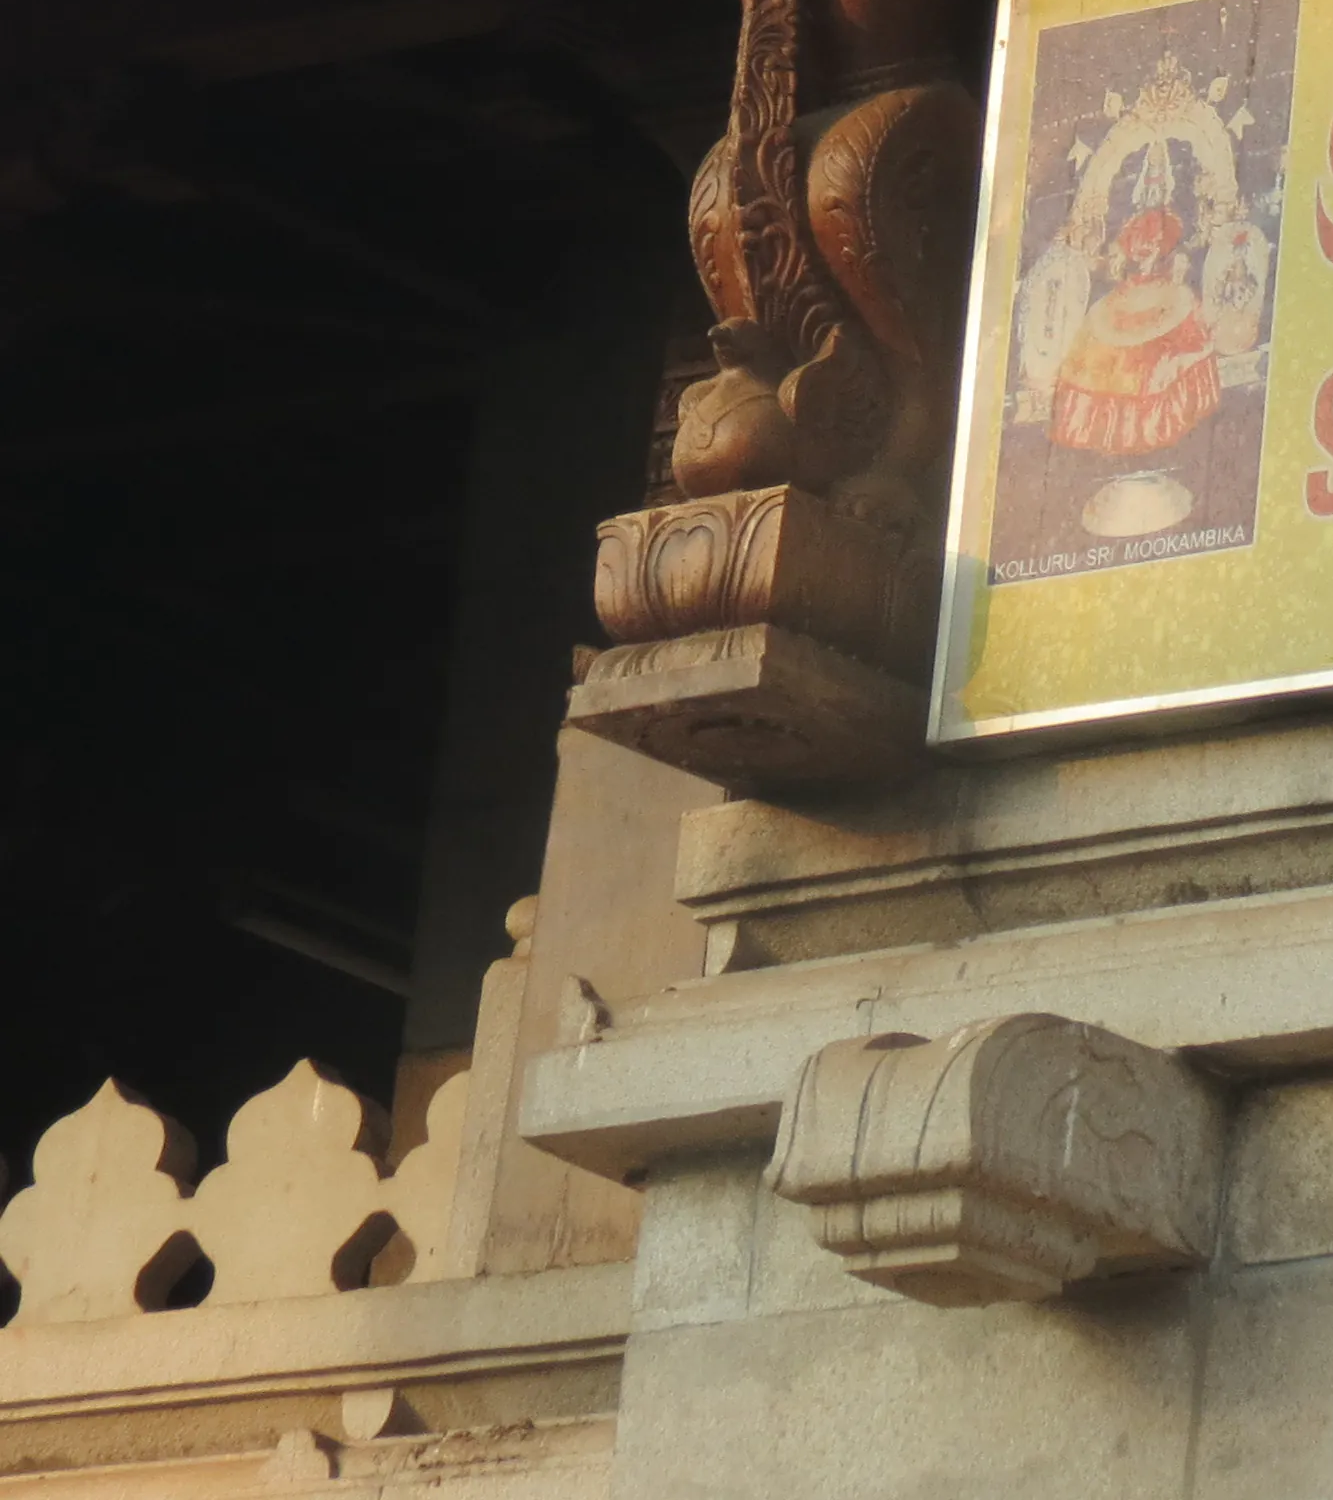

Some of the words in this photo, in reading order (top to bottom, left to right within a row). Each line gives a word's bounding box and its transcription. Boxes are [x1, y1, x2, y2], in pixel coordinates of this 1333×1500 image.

[994, 552, 1077, 582] KOLLURU
[1087, 546, 1116, 568] SRI
[1123, 523, 1247, 562] MOOKAMBIKA
